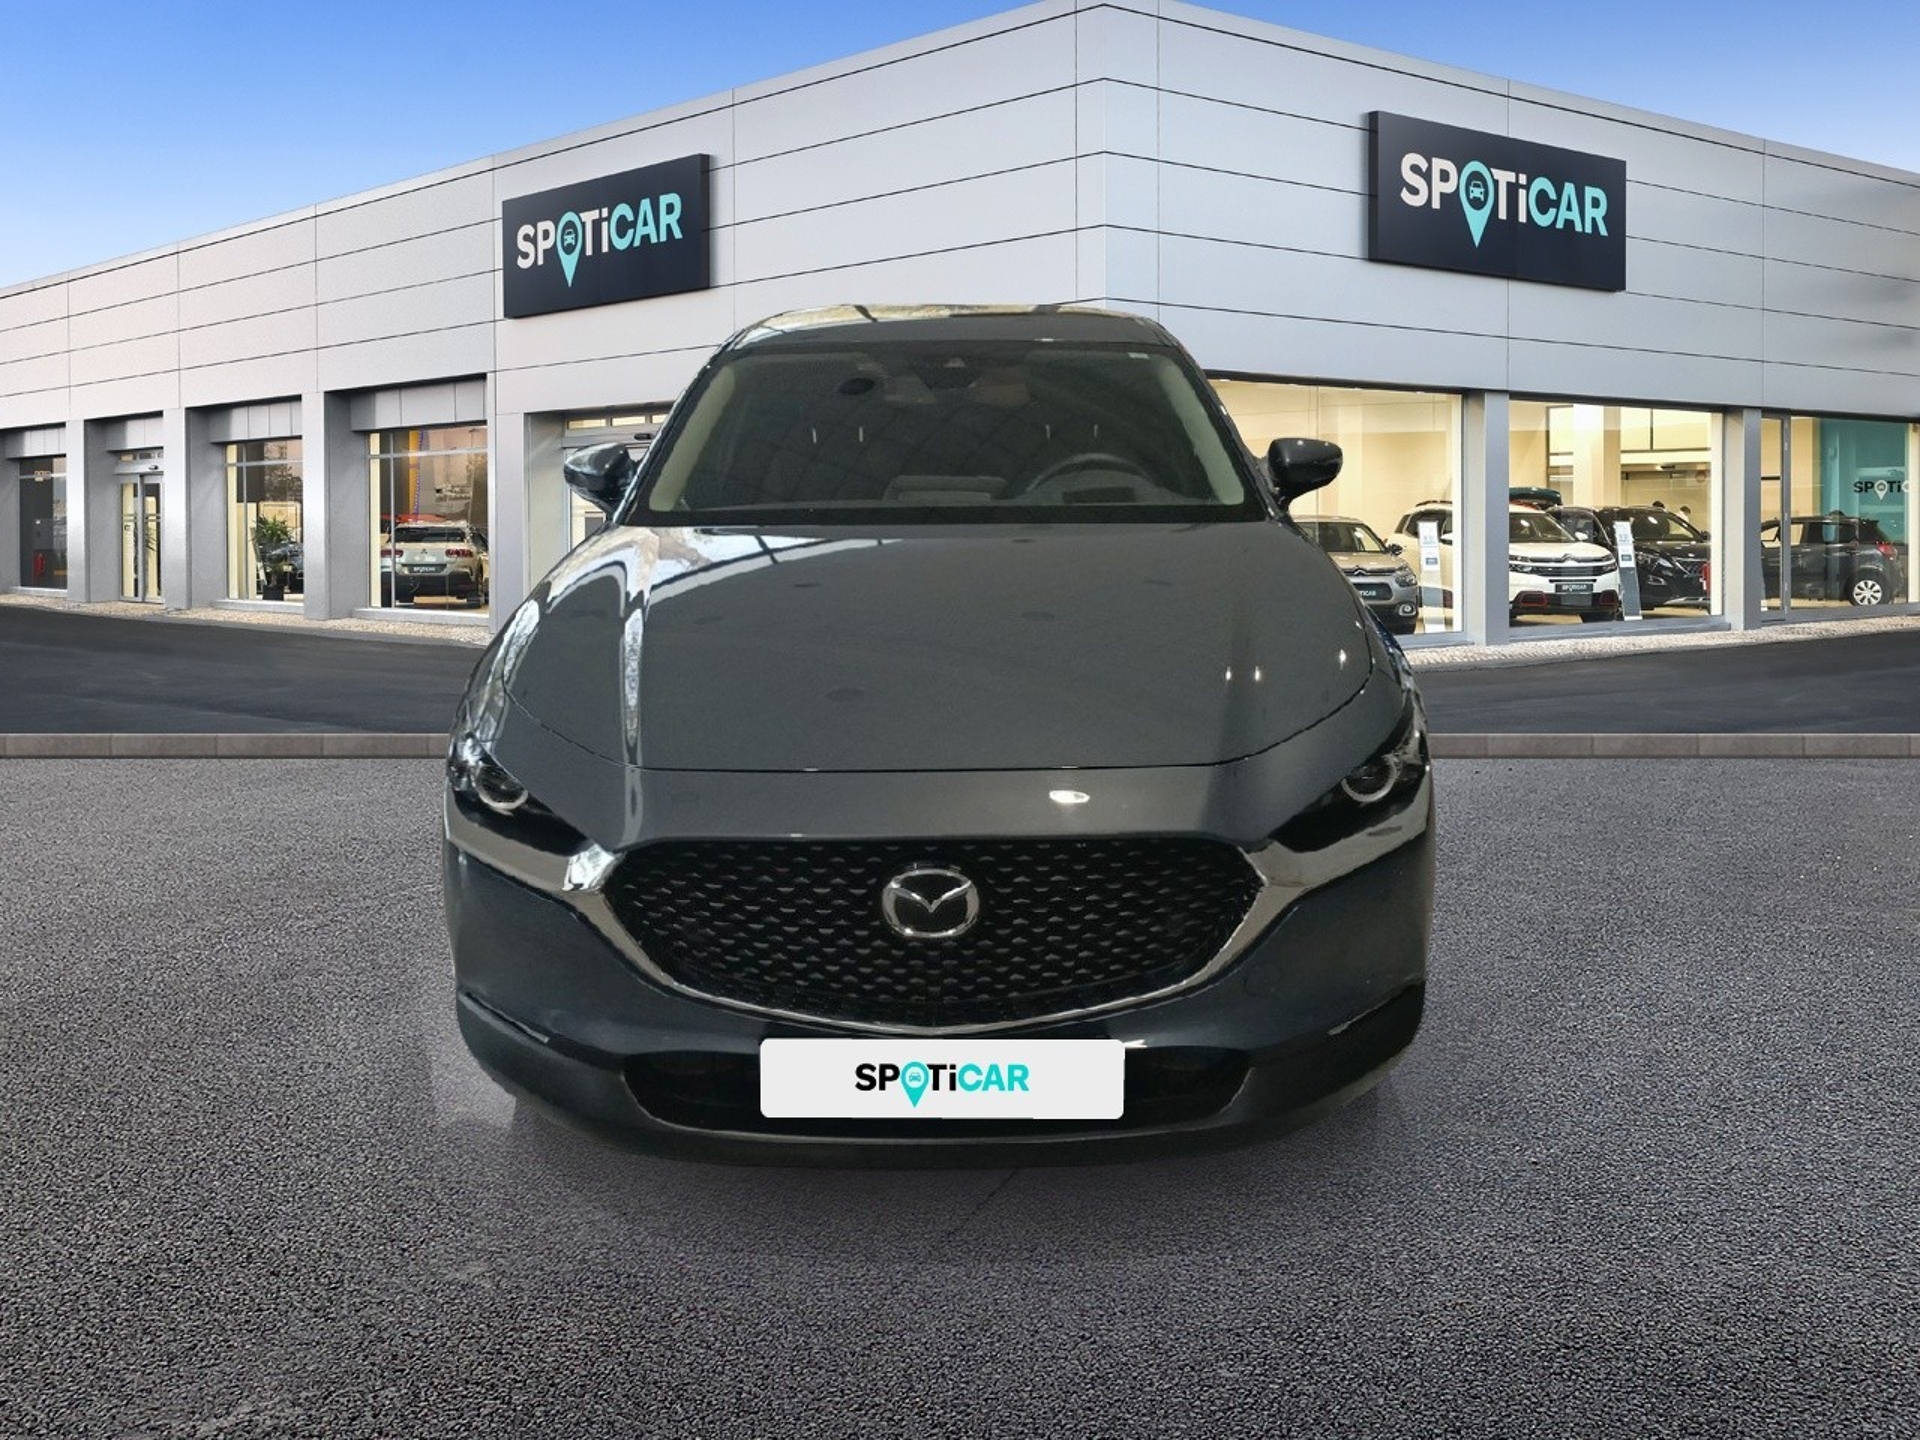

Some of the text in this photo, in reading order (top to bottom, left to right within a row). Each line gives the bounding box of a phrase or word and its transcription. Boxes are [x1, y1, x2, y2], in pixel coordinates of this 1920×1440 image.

[517, 192, 683, 288] SPOTiCAR
[1400, 152, 1608, 248] SPOTiCAR
[855, 1061, 1030, 1108] SPOTiCAR
